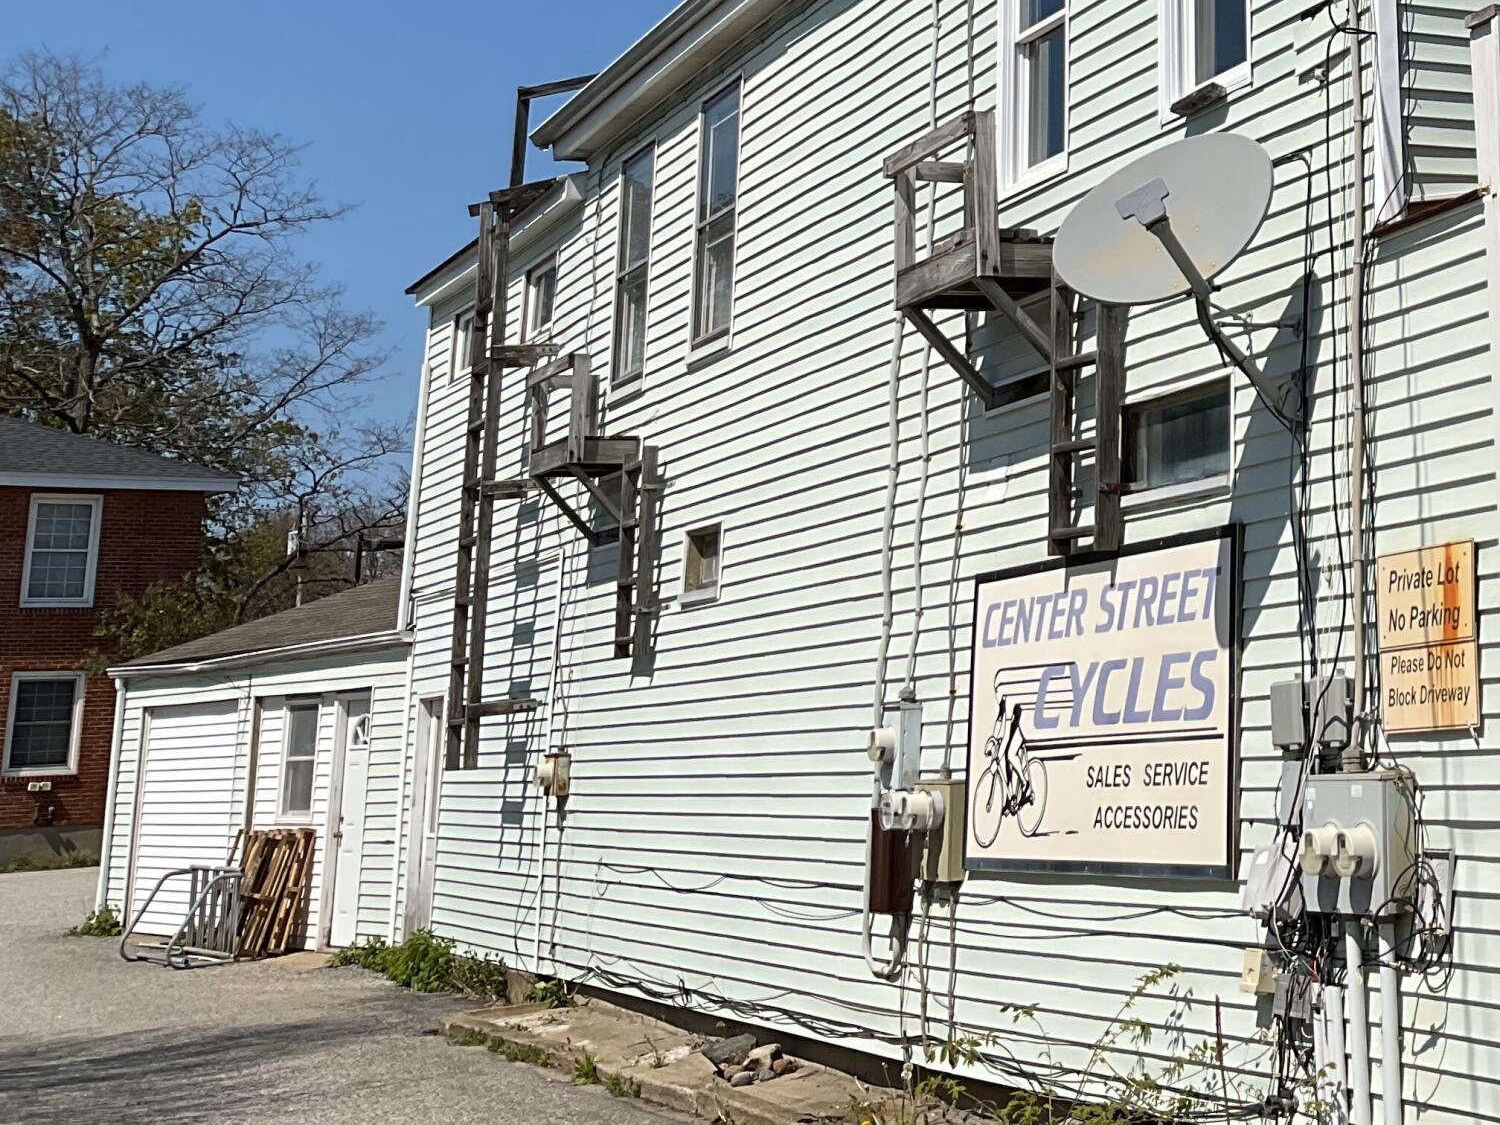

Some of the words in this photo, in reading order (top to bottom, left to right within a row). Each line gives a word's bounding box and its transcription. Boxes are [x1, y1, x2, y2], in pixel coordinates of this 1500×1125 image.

[1388, 569, 1433, 594] Private
[1437, 560, 1460, 586] Lot
[982, 587, 1088, 649] CENTER
[1095, 566, 1222, 634] STREET
[1388, 608, 1406, 632] No
[1410, 602, 1460, 630] Parking
[1391, 655, 1424, 675] Please
[1427, 651, 1442, 671] Do
[1445, 649, 1465, 669] Not
[1033, 649, 1218, 730] CYCLES
[1388, 686, 1416, 707] Block
[1420, 685, 1470, 706] Driveway
[1086, 764, 1131, 789] SALES
[1143, 761, 1209, 787] SERVICE
[1093, 805, 1199, 830] ACCESSORIES
